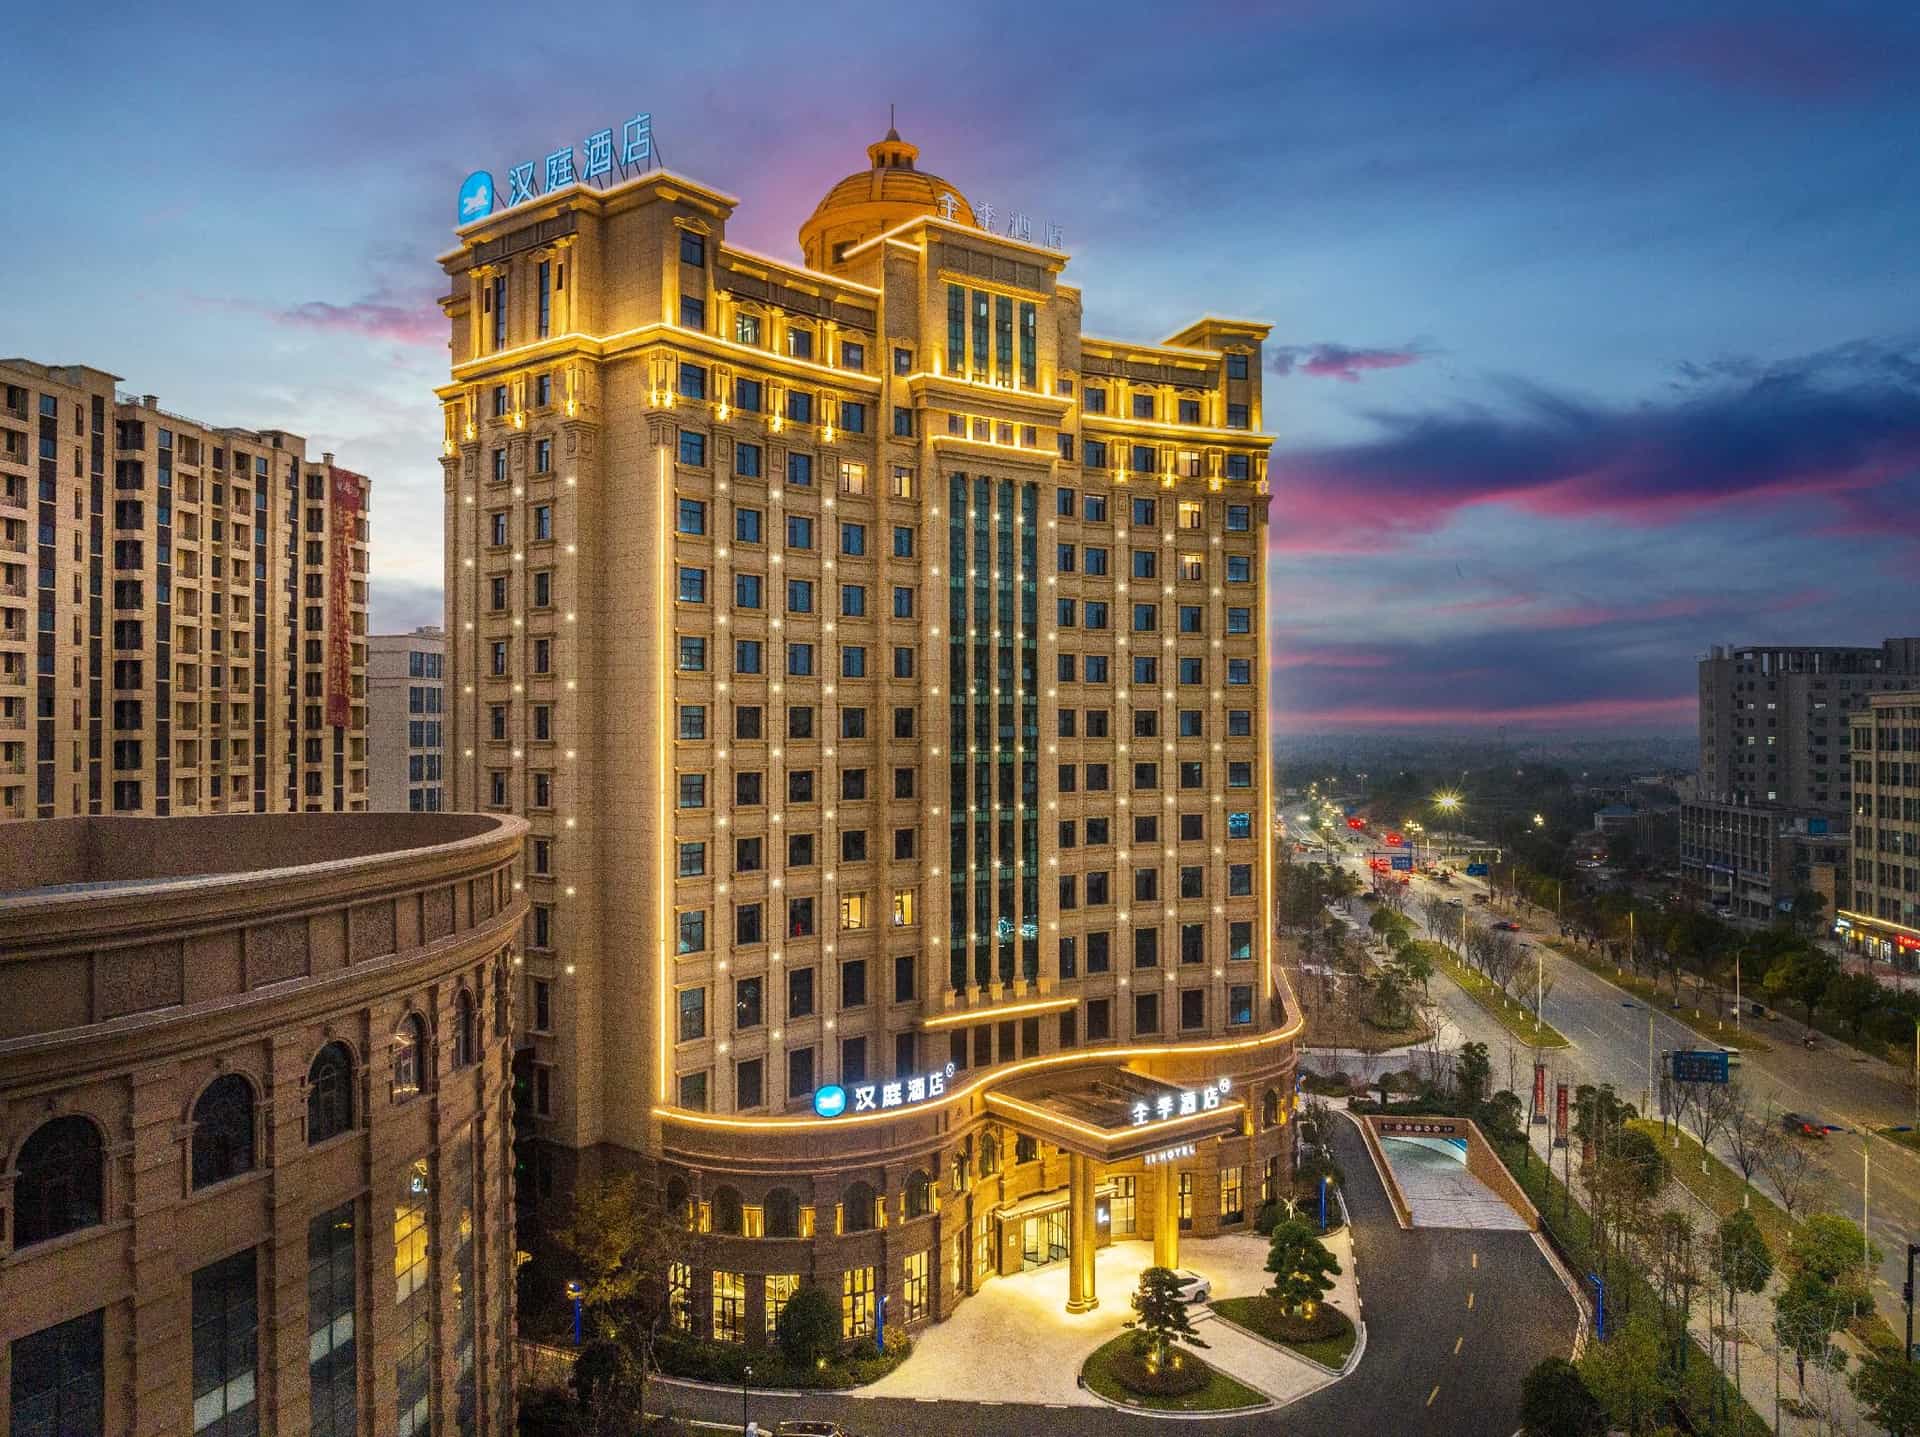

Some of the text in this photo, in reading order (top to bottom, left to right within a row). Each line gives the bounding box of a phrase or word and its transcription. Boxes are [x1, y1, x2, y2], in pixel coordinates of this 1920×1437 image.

[508, 113, 651, 208] 汉庭酒店
[855, 1072, 945, 1111] 汉庭酒店
[1132, 1086, 1219, 1126] 全季酒店
[1160, 1144, 1196, 1161] HOTEL
